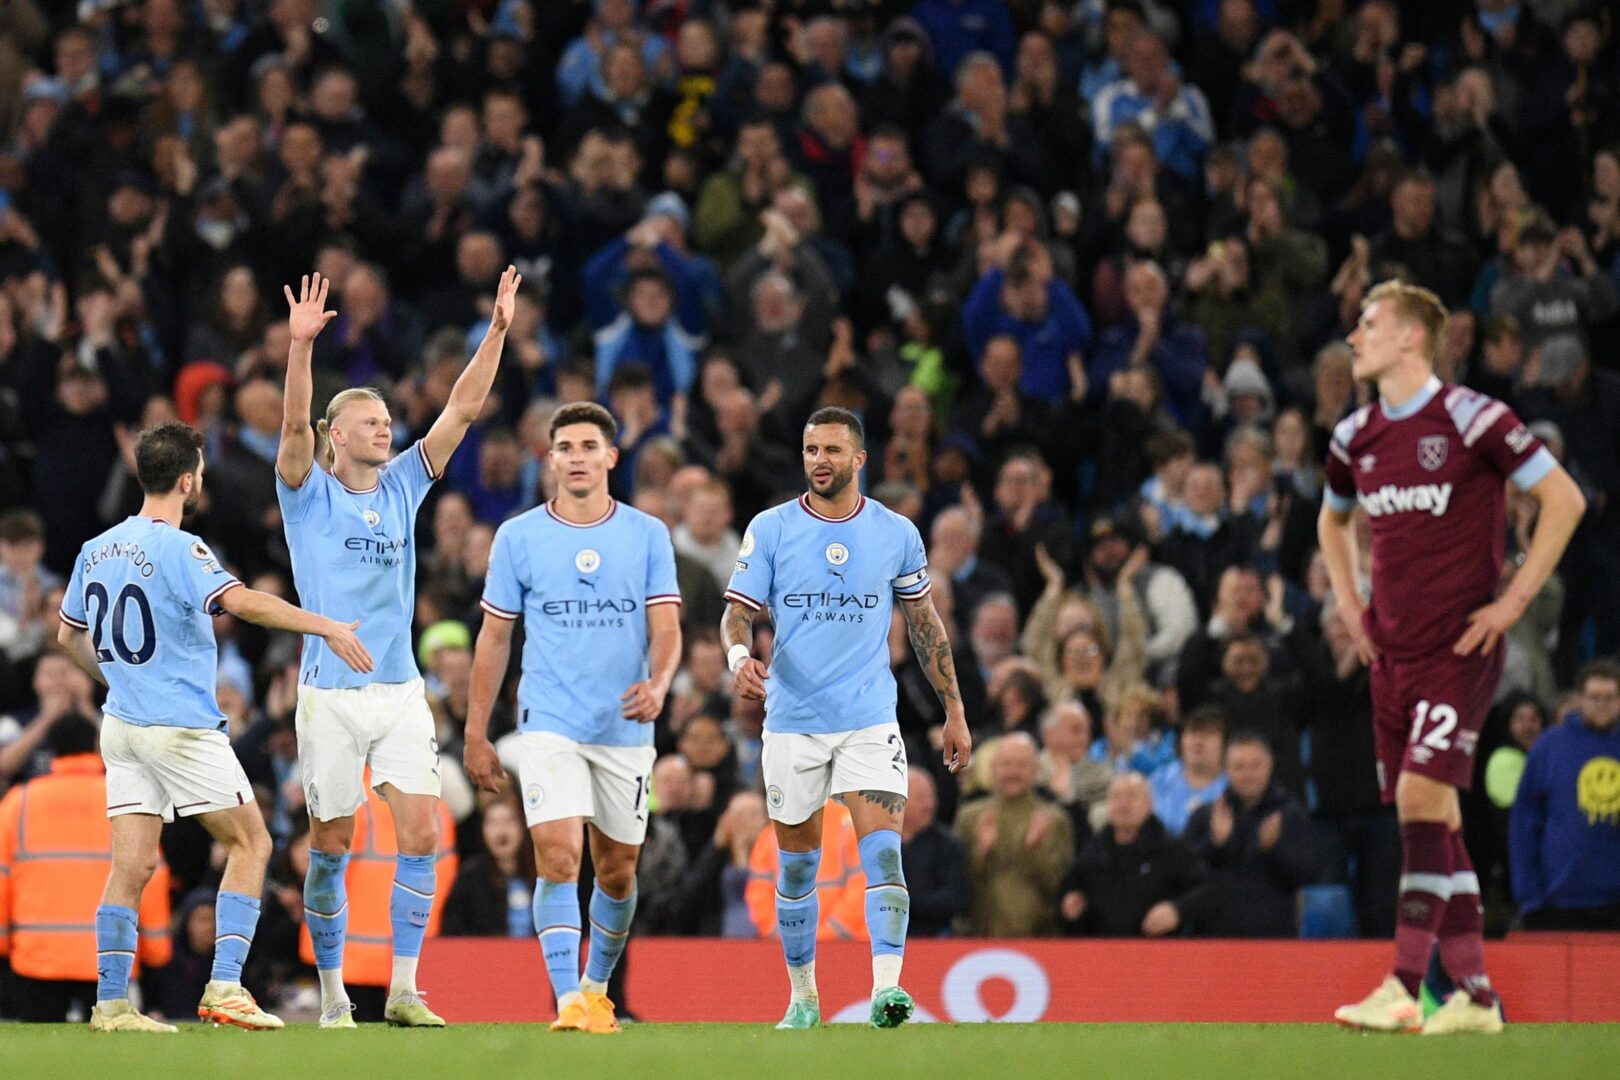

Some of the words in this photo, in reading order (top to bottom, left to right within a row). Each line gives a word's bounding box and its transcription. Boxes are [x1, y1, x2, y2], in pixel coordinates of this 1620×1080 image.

[84, 542, 154, 578] BERNARDO
[542, 598, 637, 616] ETIHAD
[783, 592, 879, 609] ETIHAD
[85, 581, 156, 665] 20
[562, 617, 624, 628] AIRWAYS
[801, 611, 864, 624] AIRWAYS
[1410, 699, 1458, 751] 12
[887, 733, 906, 765] 2
[880, 905, 907, 915] CITY
[779, 918, 806, 927] CITY
